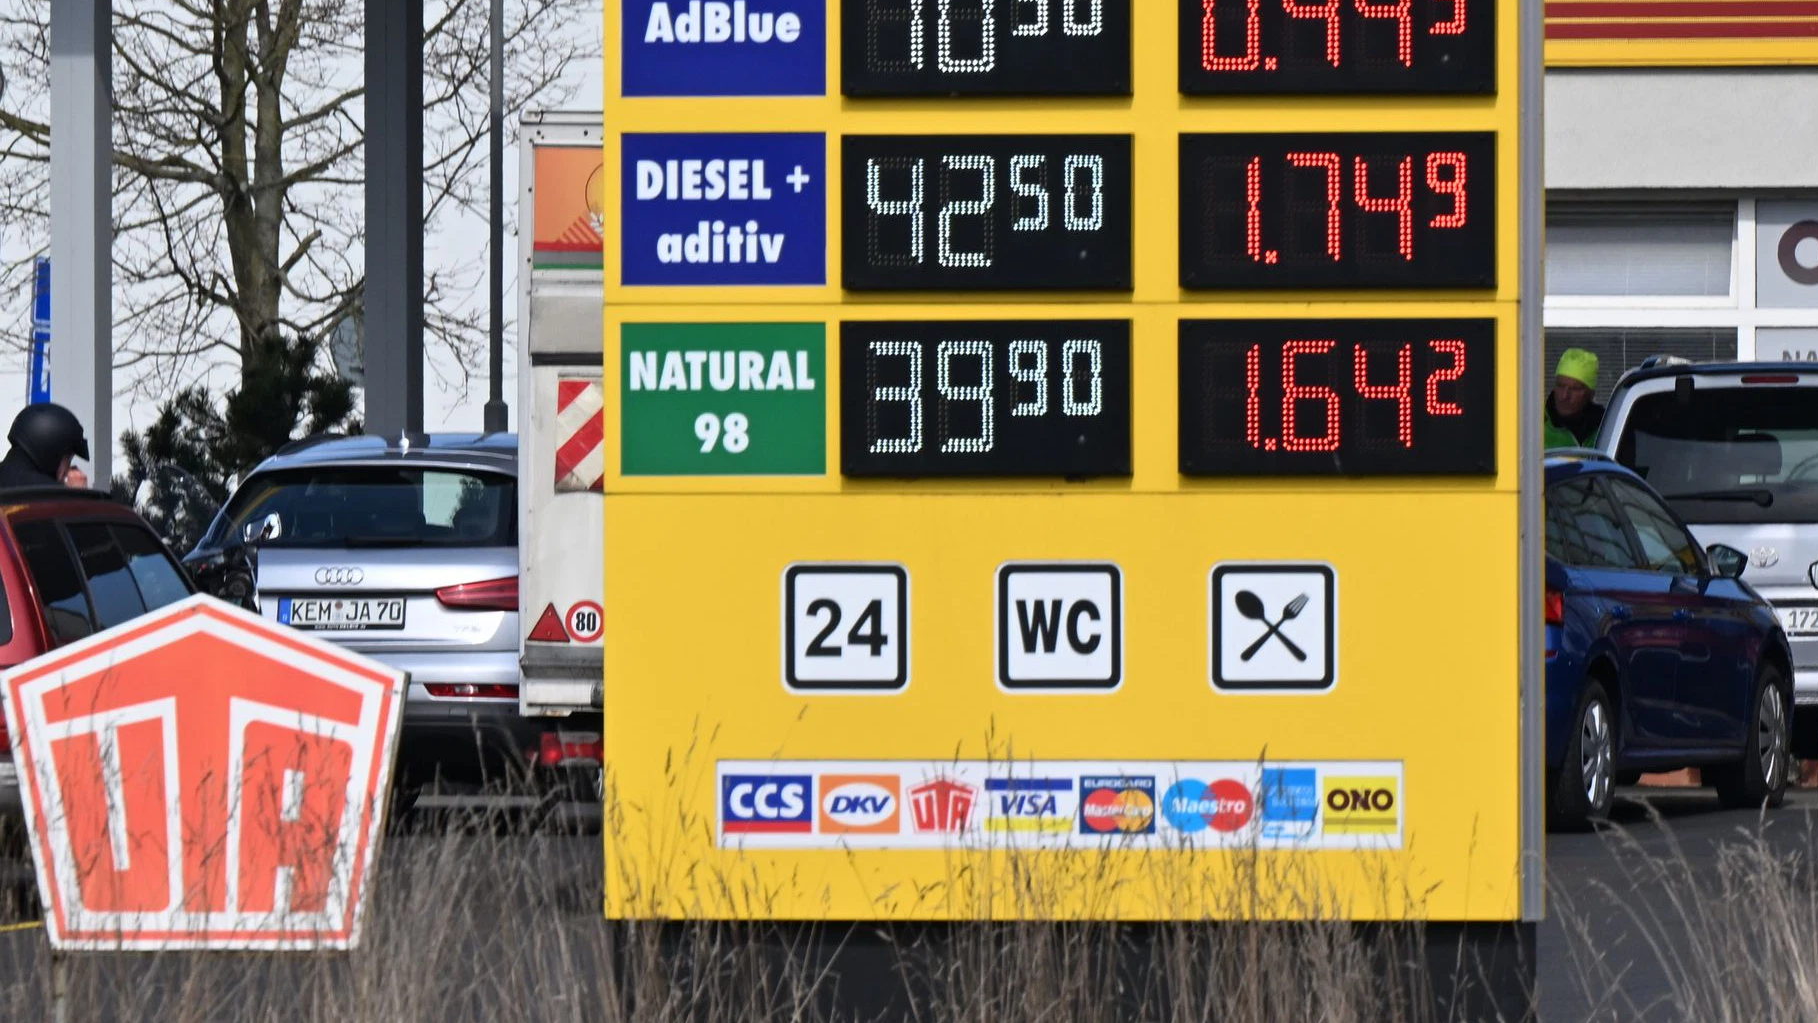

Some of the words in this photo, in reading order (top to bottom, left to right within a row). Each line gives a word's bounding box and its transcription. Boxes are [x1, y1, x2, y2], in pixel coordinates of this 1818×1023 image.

[644, 0, 801, 44] AdBlue
[636, 159, 772, 200] DIESEL
[786, 165, 810, 194] +
[656, 220, 785, 264] aditiv
[629, 350, 815, 392] NATURAL
[694, 412, 750, 454] 98
[291, 601, 332, 622] KEM
[345, 601, 372, 622] JA
[376, 601, 402, 622] 70
[575, 611, 597, 633] 80
[805, 598, 889, 658] 24
[1015, 597, 1103, 656] WC
[729, 782, 805, 819] CCS
[830, 795, 891, 815] DKV
[1000, 794, 1059, 816] VISA
[1171, 796, 1246, 816] Maestro
[1326, 789, 1395, 812] ONO
